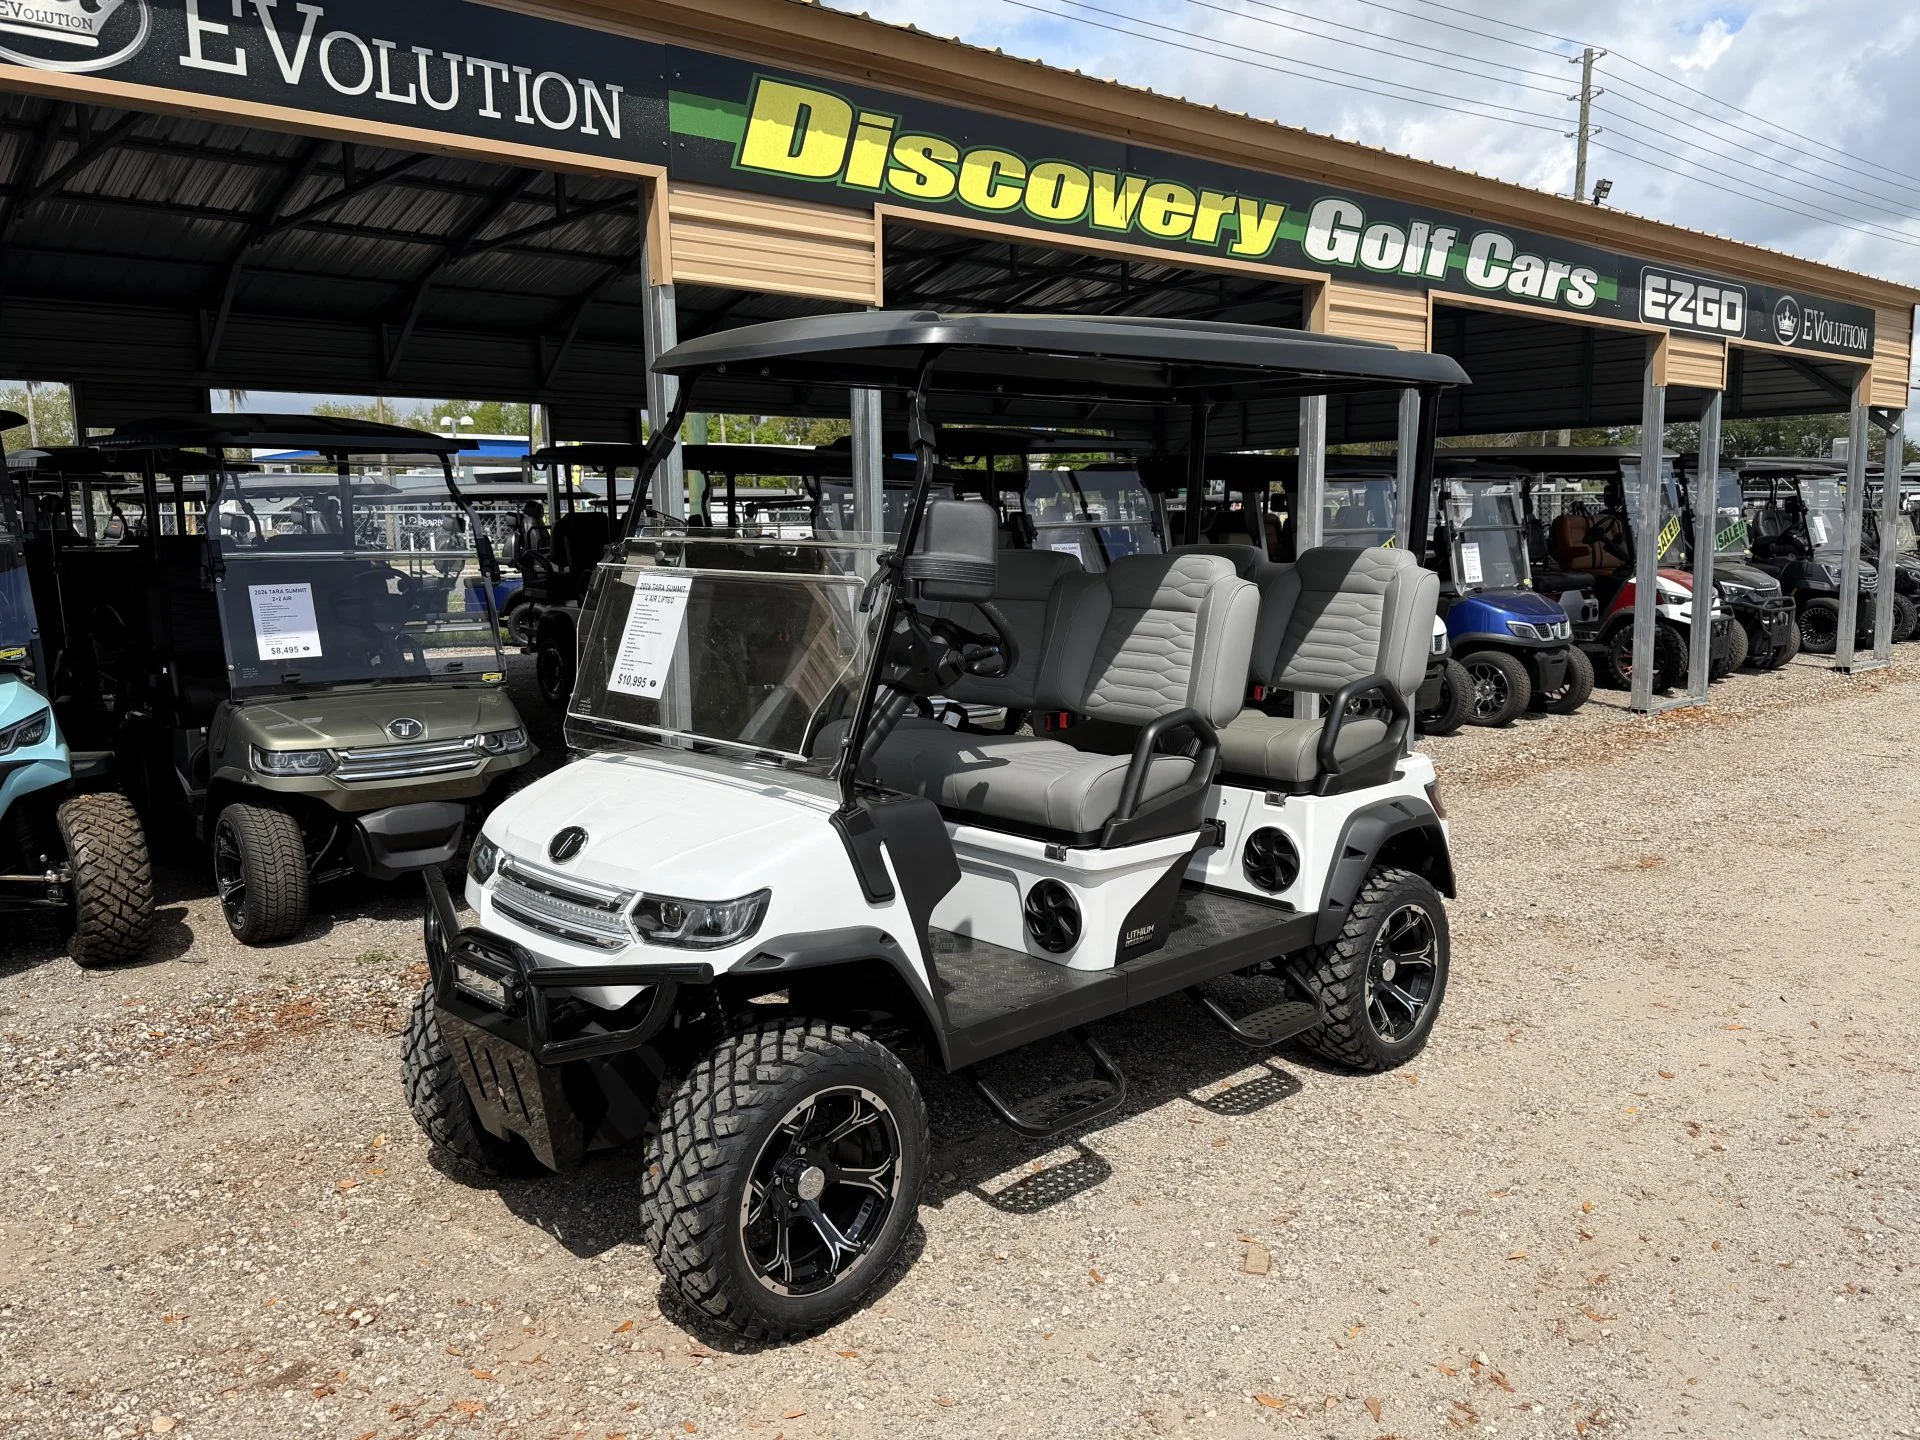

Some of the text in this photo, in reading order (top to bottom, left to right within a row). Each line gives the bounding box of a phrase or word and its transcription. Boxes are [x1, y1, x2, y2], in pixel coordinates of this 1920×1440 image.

[737, 77, 1599, 309] Discovery Golf Cars
[1644, 274, 1743, 332] EZGO
[652, 583, 665, 592] TARA
[666, 584, 687, 593] SUMMIT
[657, 596, 675, 604] LIFTED
[271, 646, 299, 655] $8,495
[617, 673, 648, 688] $10,995
[1126, 924, 1155, 940] LITHIUM
